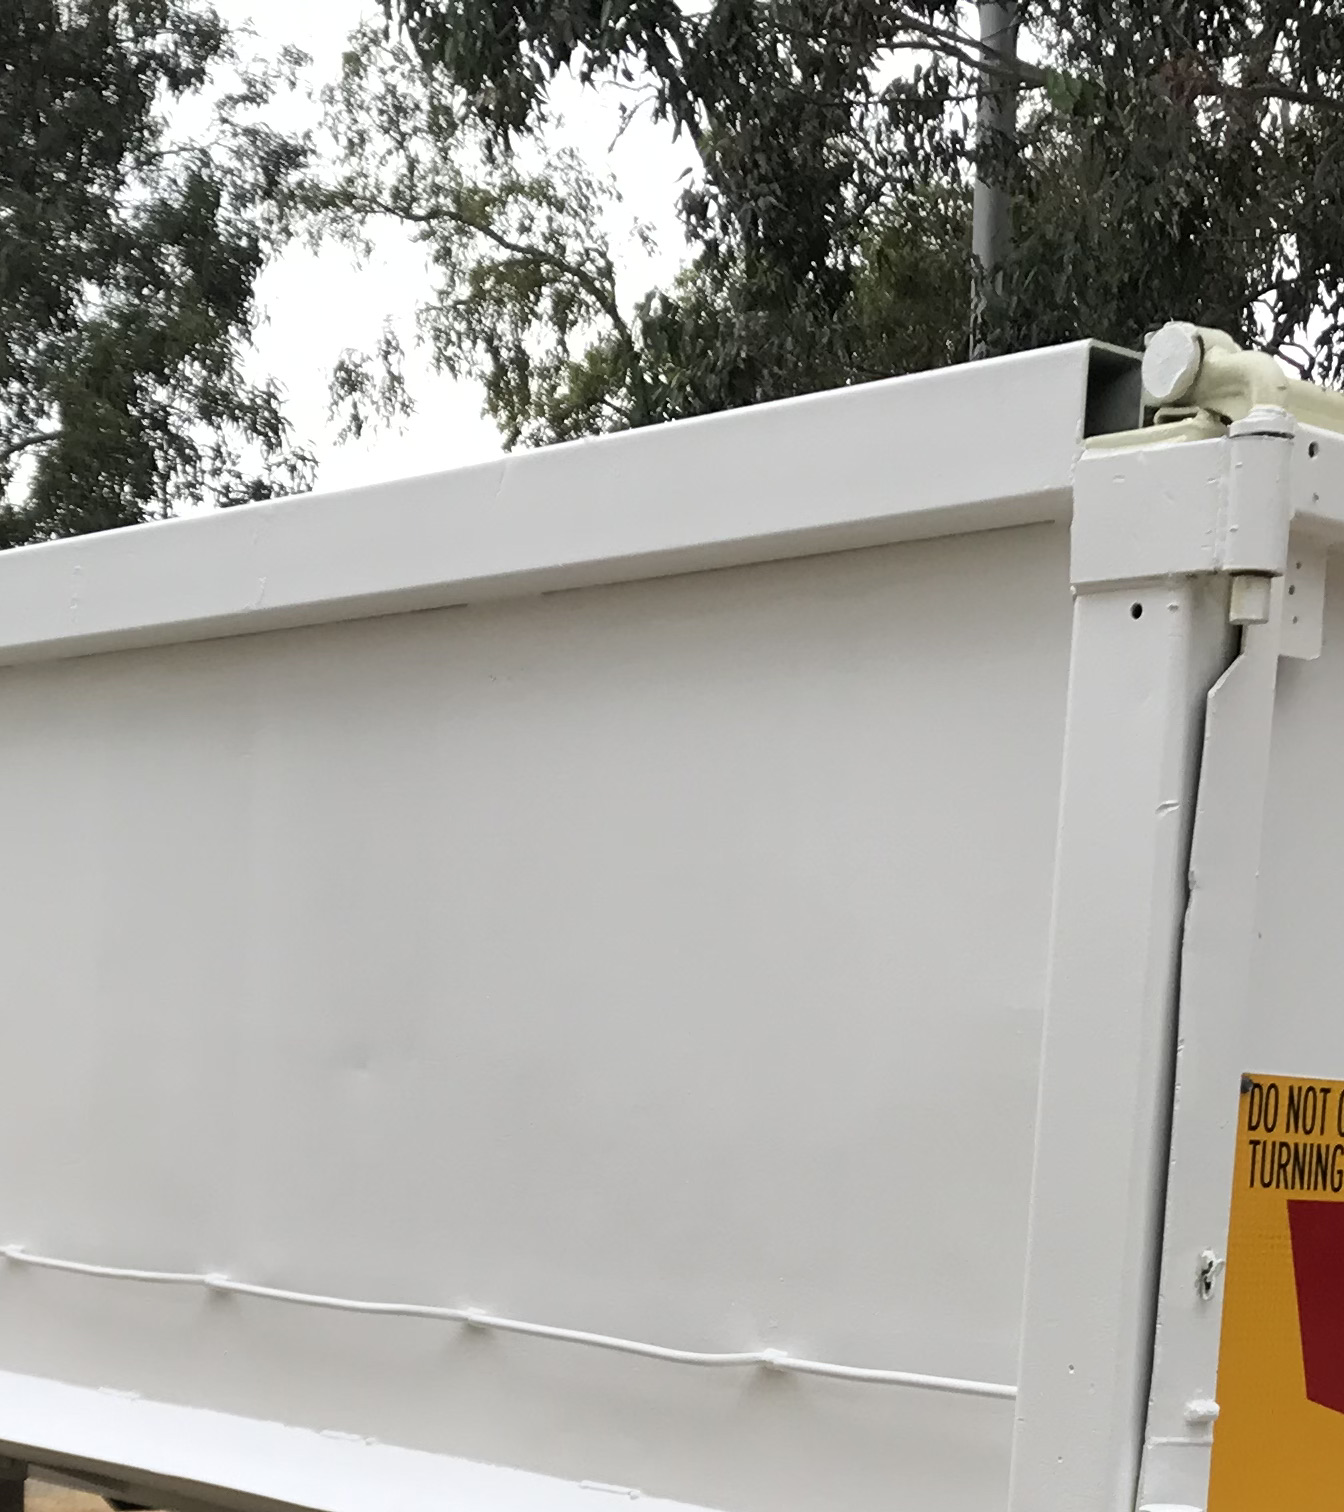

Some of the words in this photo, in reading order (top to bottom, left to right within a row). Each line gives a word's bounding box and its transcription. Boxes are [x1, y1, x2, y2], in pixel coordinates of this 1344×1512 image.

[1247, 1082, 1280, 1133] DO
[1285, 1084, 1332, 1136] NOT
[1248, 1139, 1344, 1193] TURNING
